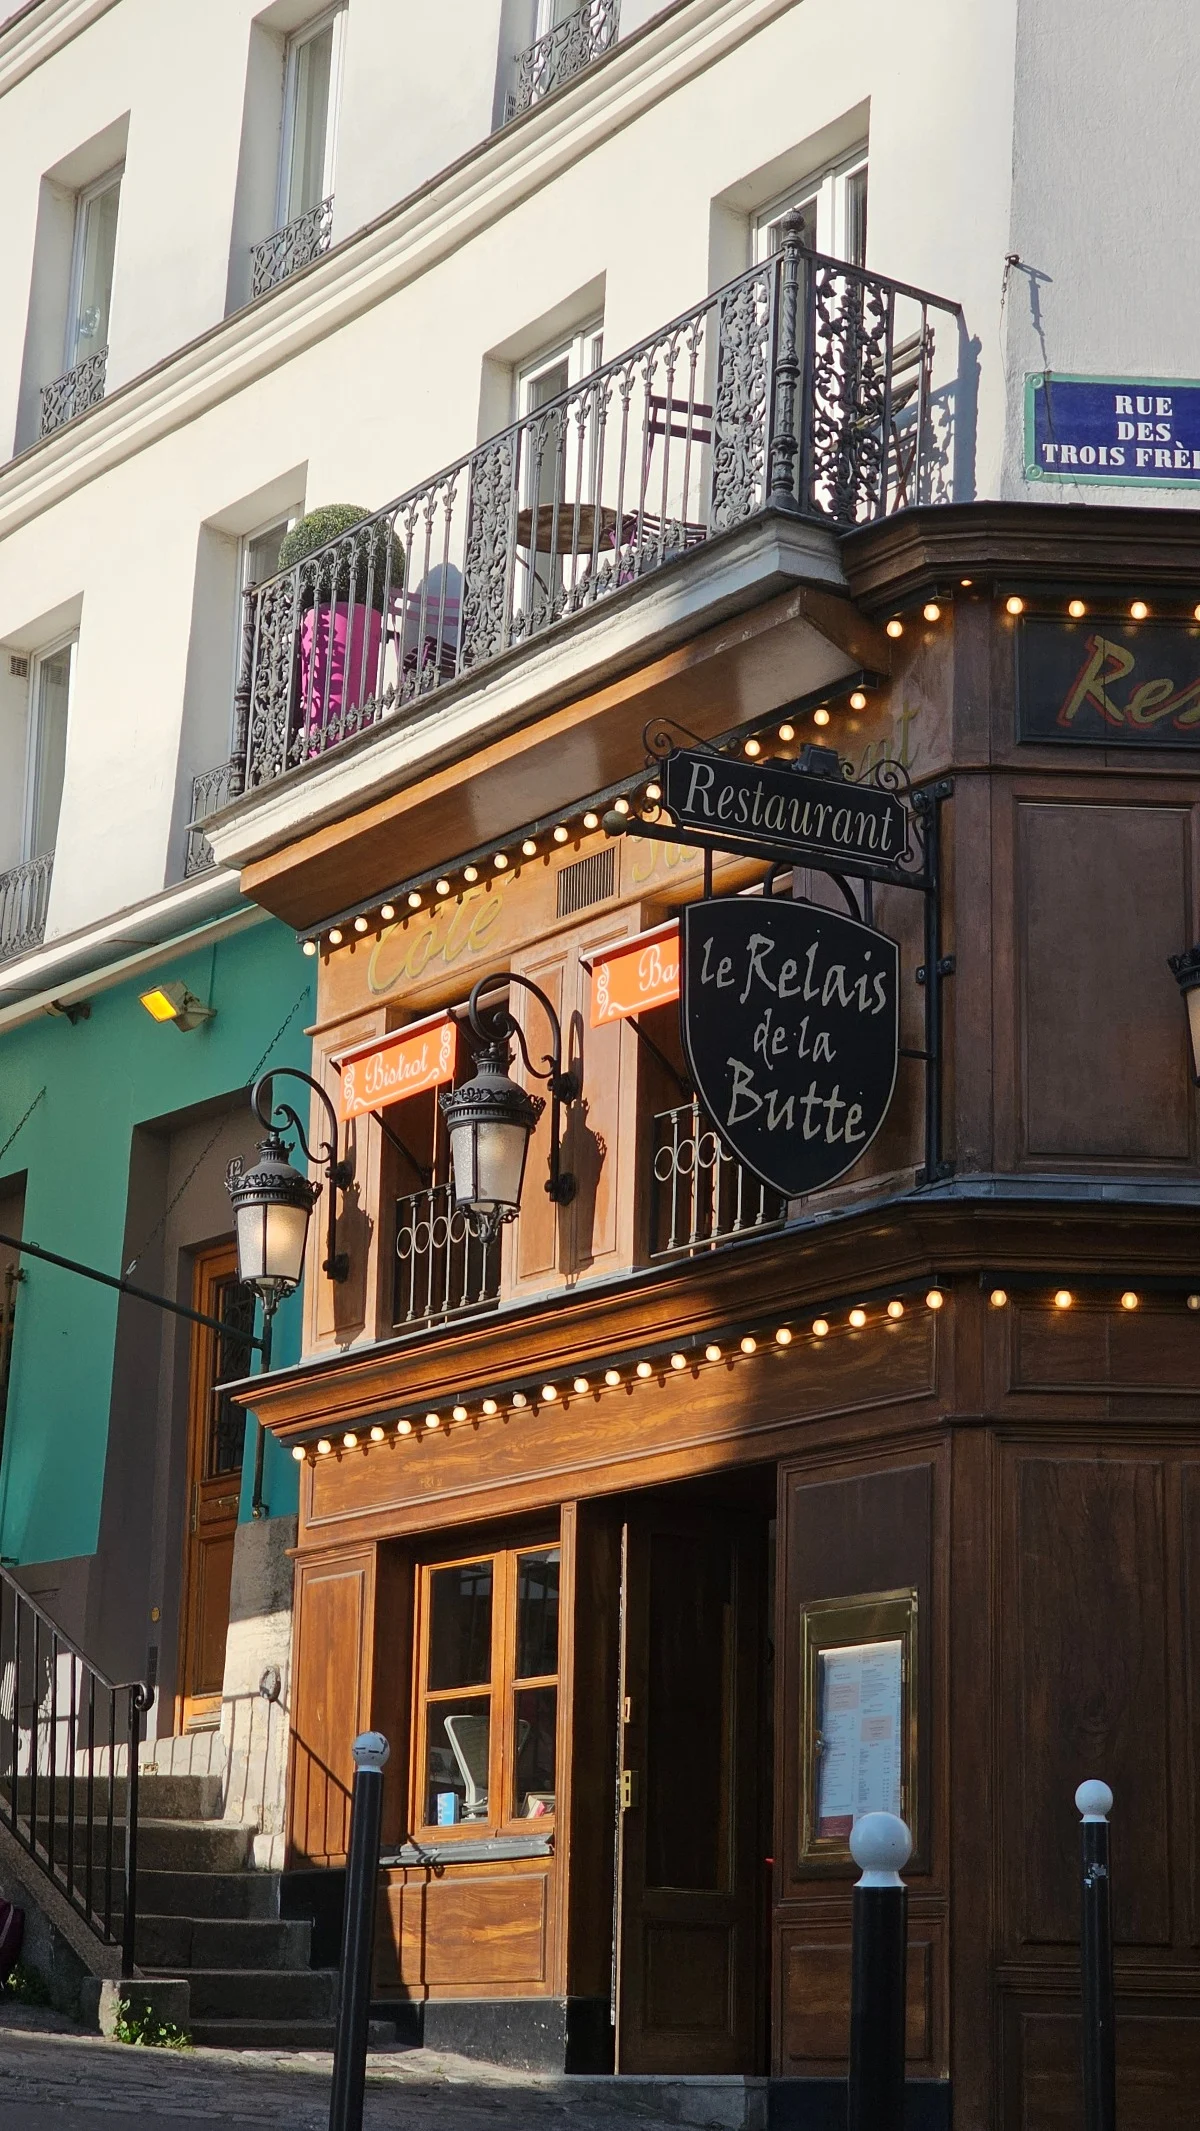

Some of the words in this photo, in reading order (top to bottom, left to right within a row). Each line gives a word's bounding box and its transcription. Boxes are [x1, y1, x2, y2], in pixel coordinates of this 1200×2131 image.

[1115, 395, 1173, 417] RUE
[1117, 421, 1172, 442] DES
[1042, 443, 1126, 466] TROIS
[681, 761, 894, 851] Restaurant
[739, 933, 887, 1015] Relais
[753, 1007, 789, 1071] de
[798, 1015, 837, 1063] la
[365, 1043, 429, 1094] Bistrot
[726, 1056, 866, 1144] Butte
